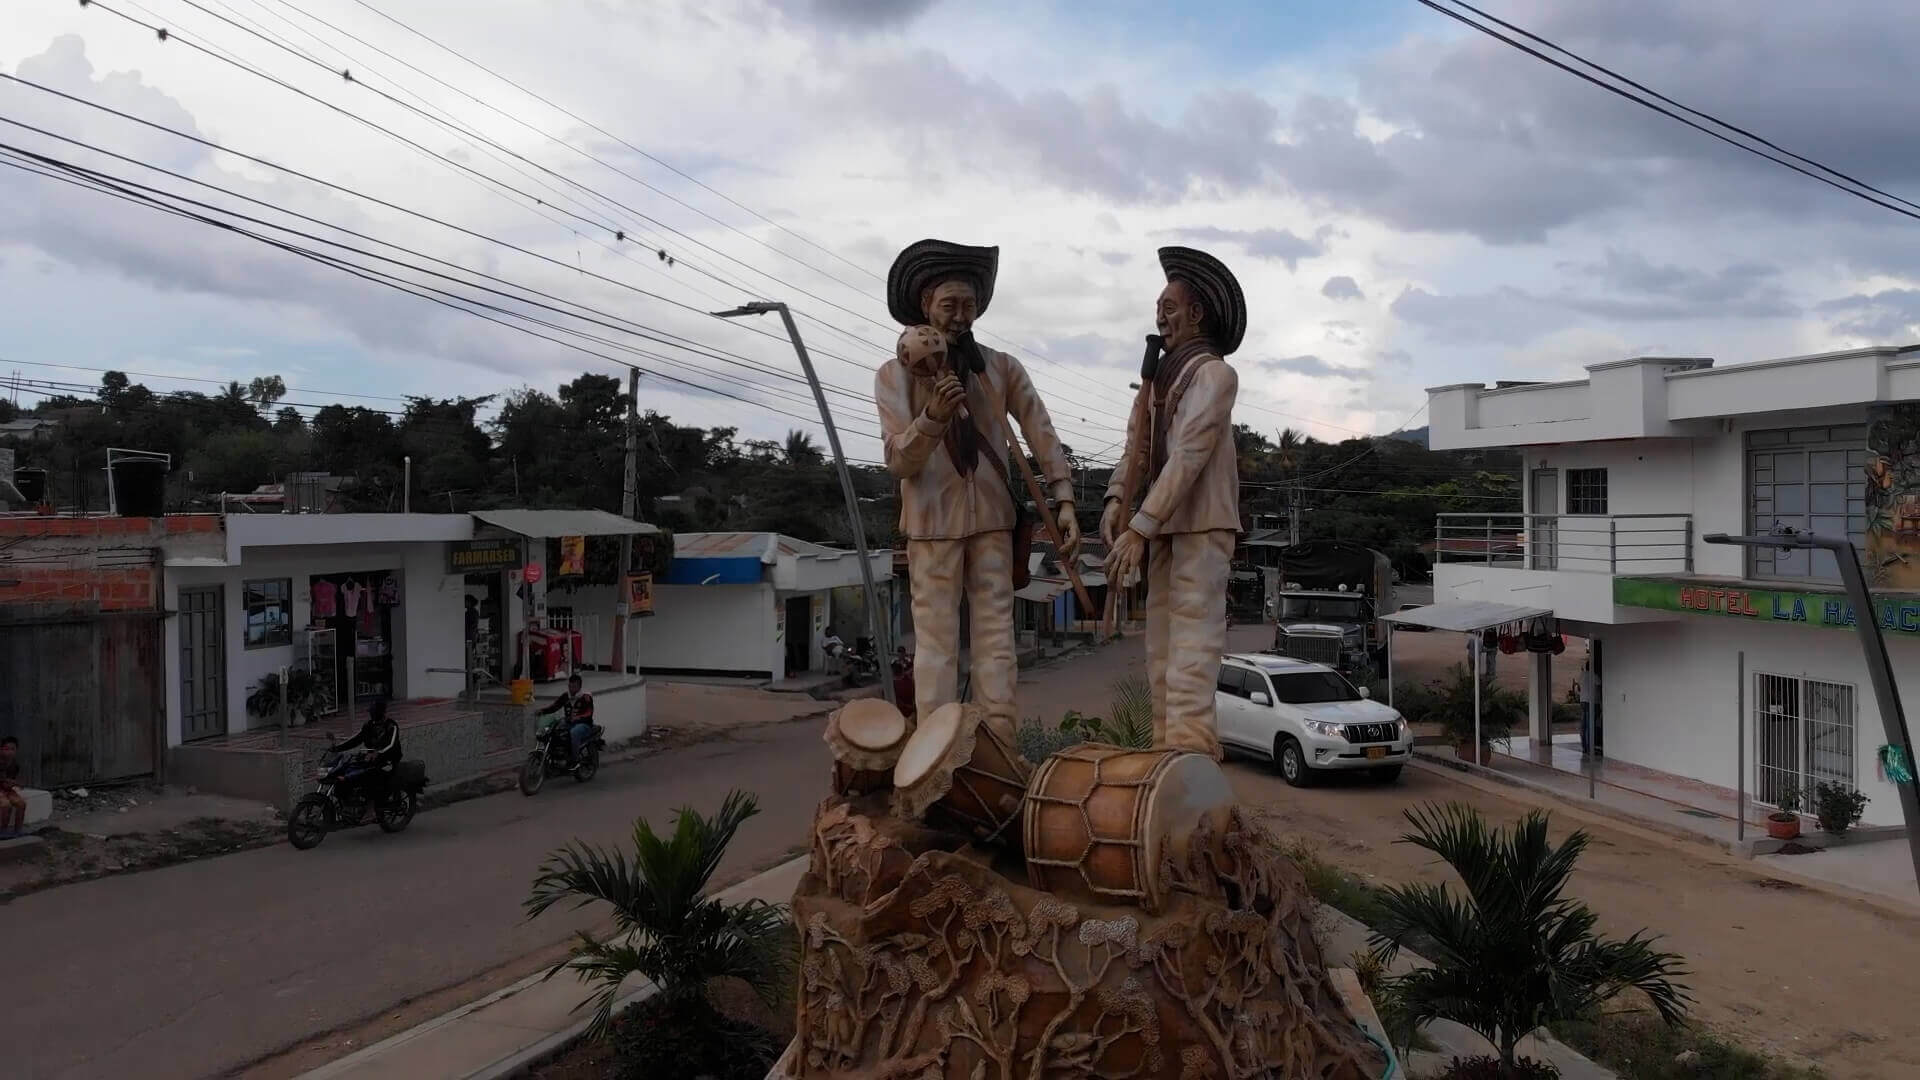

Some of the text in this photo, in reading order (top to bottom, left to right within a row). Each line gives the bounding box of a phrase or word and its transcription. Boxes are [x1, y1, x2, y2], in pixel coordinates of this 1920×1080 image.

[1681, 588, 1920, 632] HOTEL LA HAAC
